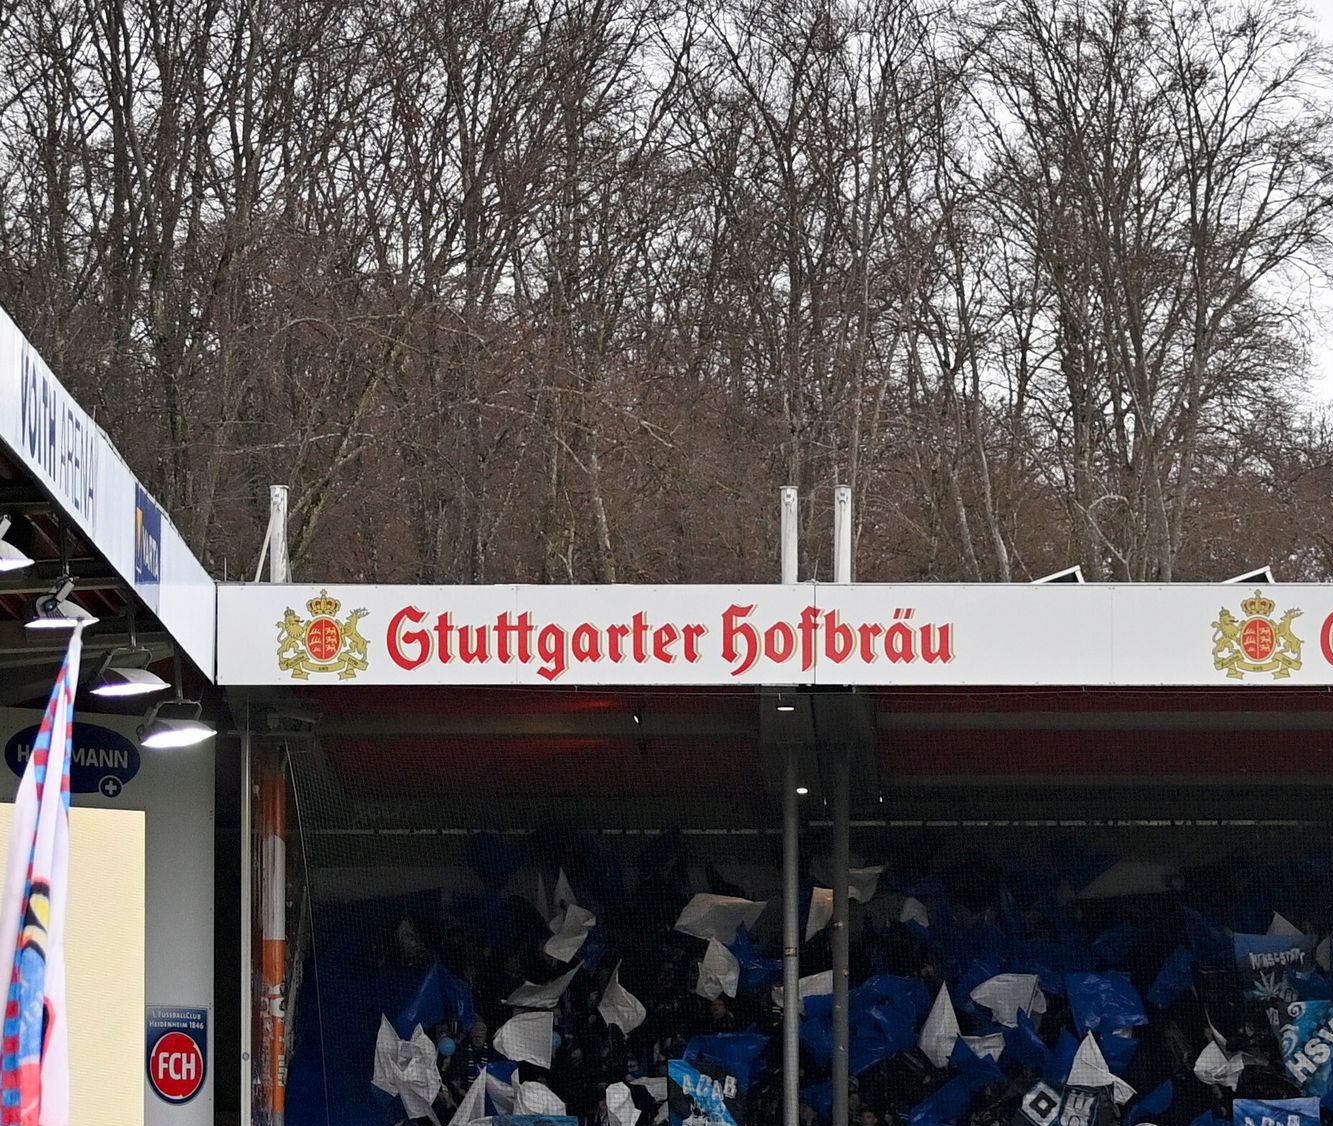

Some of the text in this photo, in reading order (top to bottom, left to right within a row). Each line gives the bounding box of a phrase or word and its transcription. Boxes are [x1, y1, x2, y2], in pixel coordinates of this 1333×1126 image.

[21, 345, 97, 530] VOITH ARENA
[386, 603, 955, 681] Stuttgarter Hofbräu
[17, 744, 129, 769] HMANN
[158, 1052, 196, 1080] FCH
